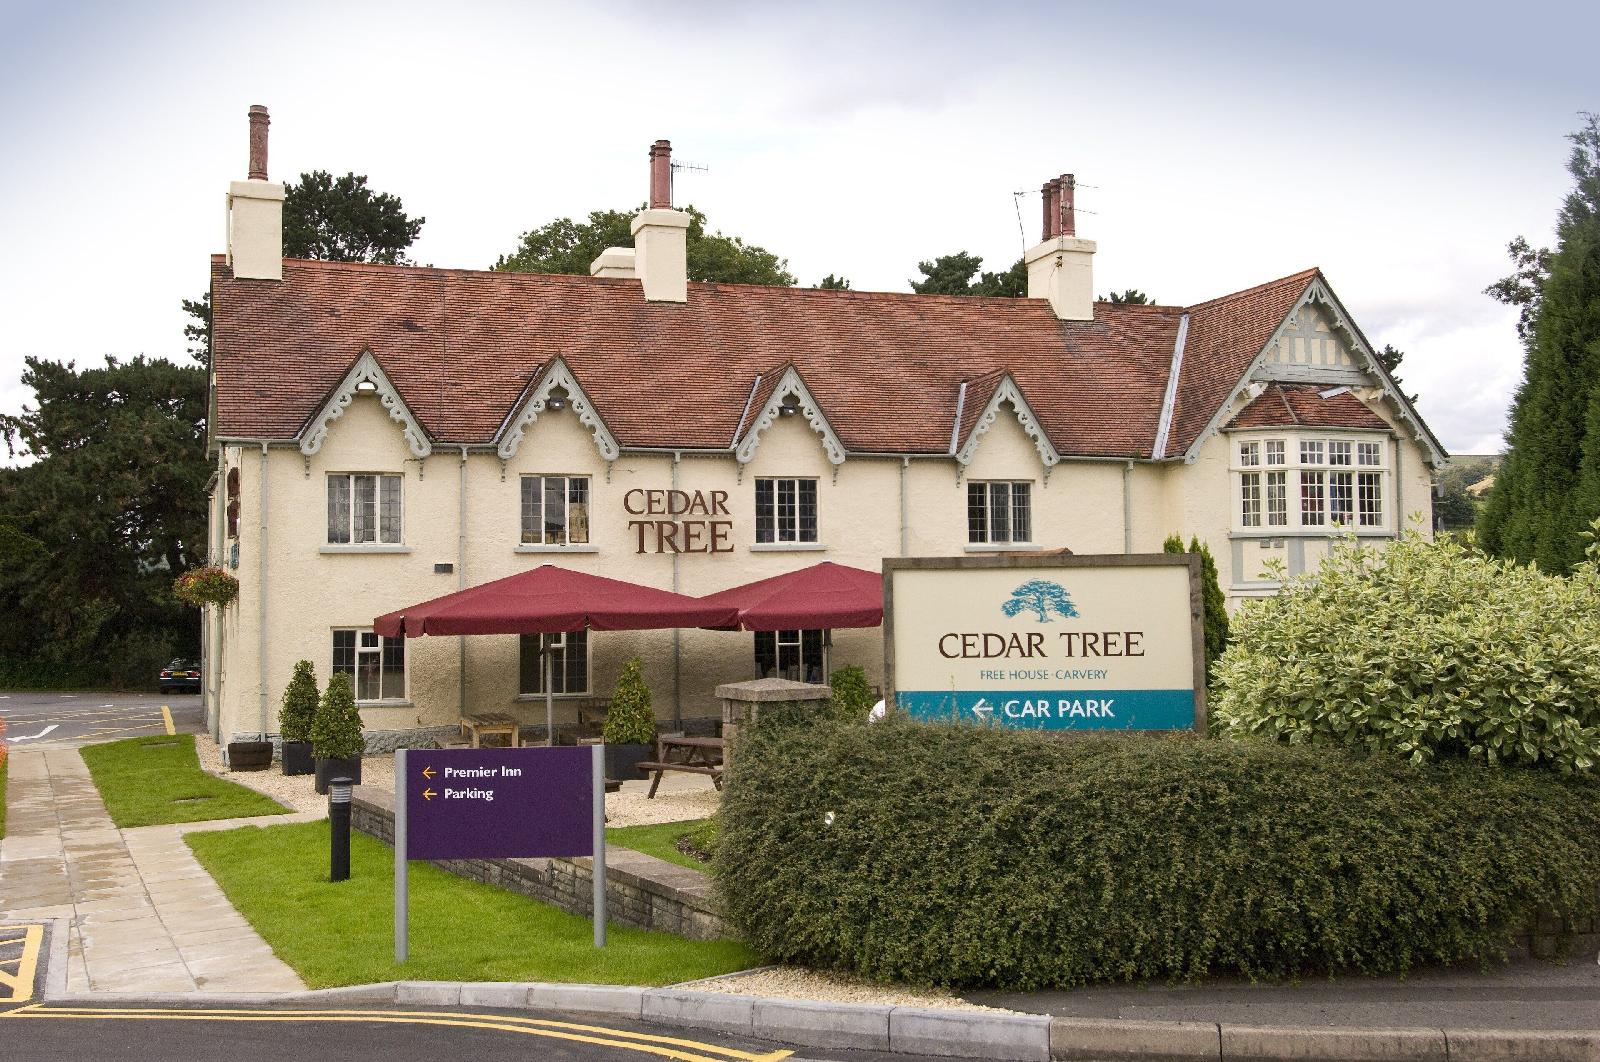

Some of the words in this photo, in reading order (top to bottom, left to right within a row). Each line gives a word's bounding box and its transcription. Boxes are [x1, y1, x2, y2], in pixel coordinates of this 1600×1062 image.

[623, 488, 731, 515] CEDAR
[628, 520, 734, 553] TREE
[938, 632, 1048, 659] CEDAR
[1059, 631, 1145, 657] TREE
[980, 670, 1005, 680] FREE
[1009, 670, 1049, 680] HOUSE
[1055, 670, 1108, 680] CARVERY
[1004, 700, 1051, 718] CAR
[1058, 700, 1115, 718] PARK
[444, 767, 498, 778] Premier
[501, 766, 522, 777] Inn
[444, 788, 494, 801] Parking
